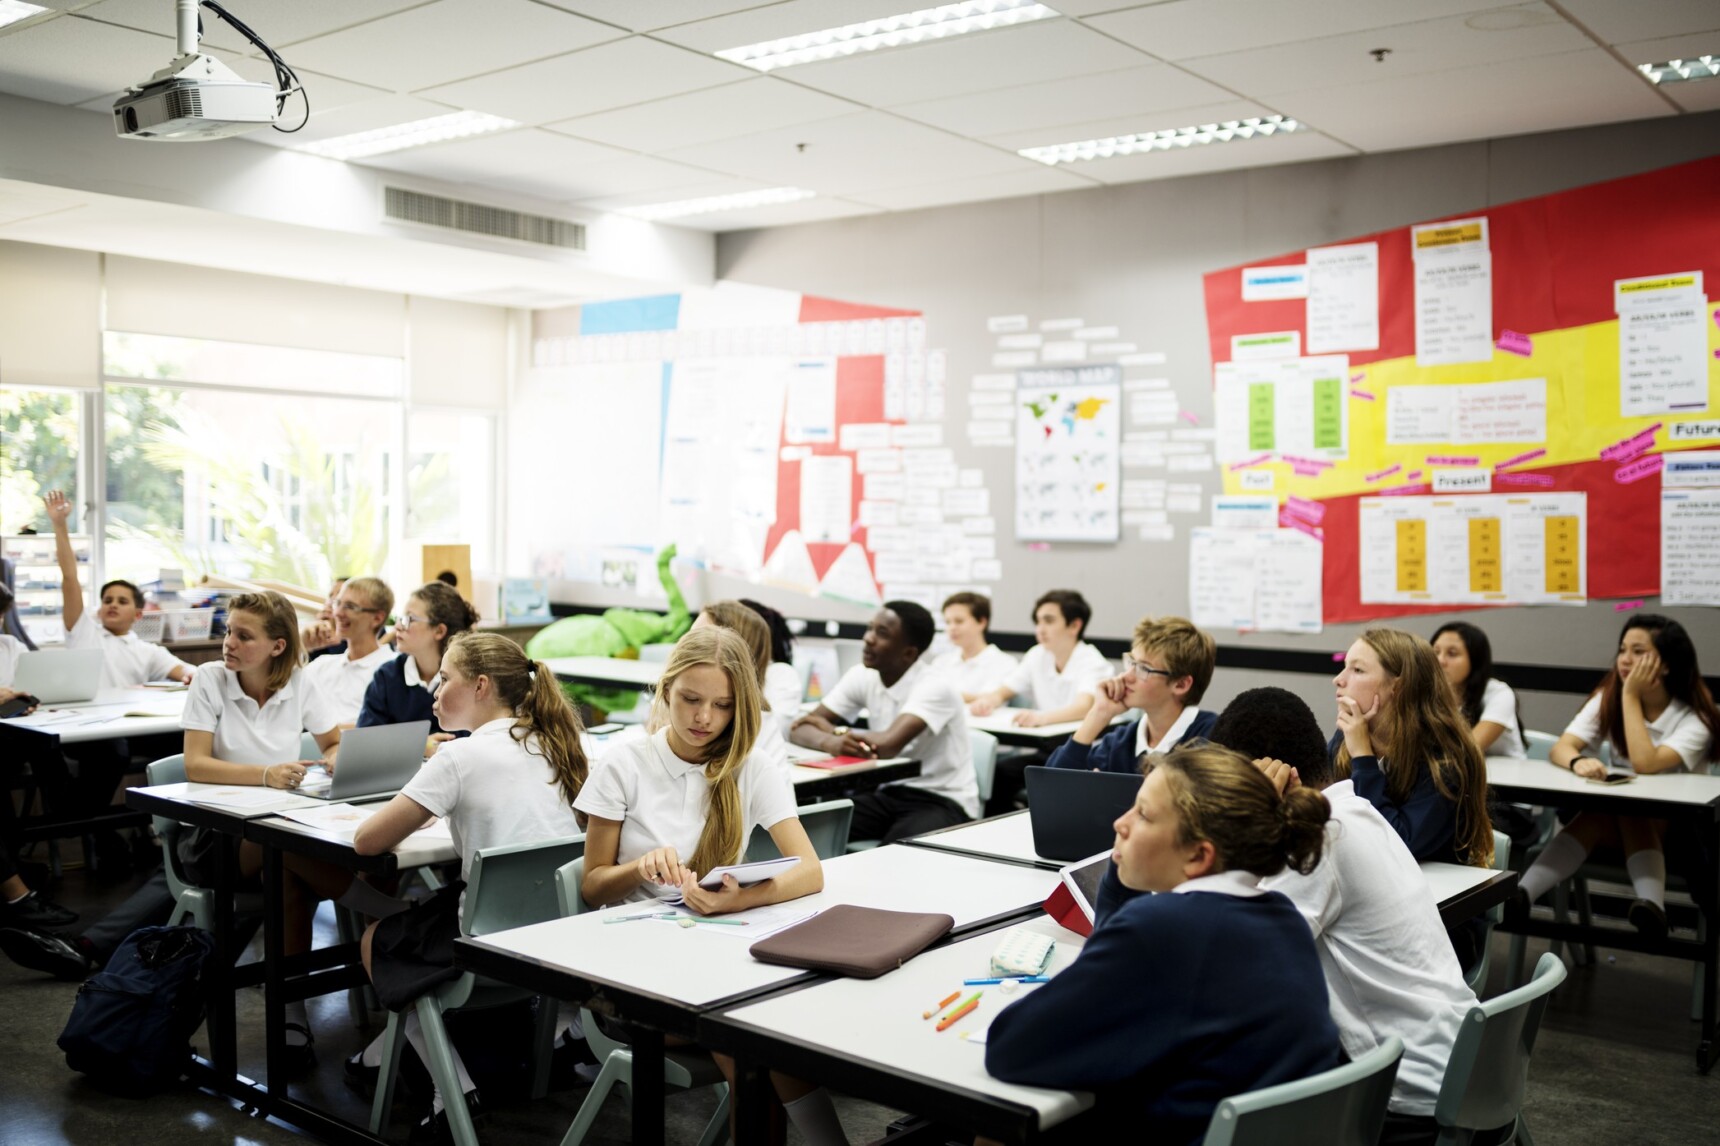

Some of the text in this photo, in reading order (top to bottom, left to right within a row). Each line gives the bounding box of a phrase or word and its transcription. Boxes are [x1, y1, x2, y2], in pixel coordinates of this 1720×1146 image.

[1021, 366, 1114, 387] WORLD MAP
[1246, 471, 1270, 484] Past
[1438, 474, 1488, 486] Present
